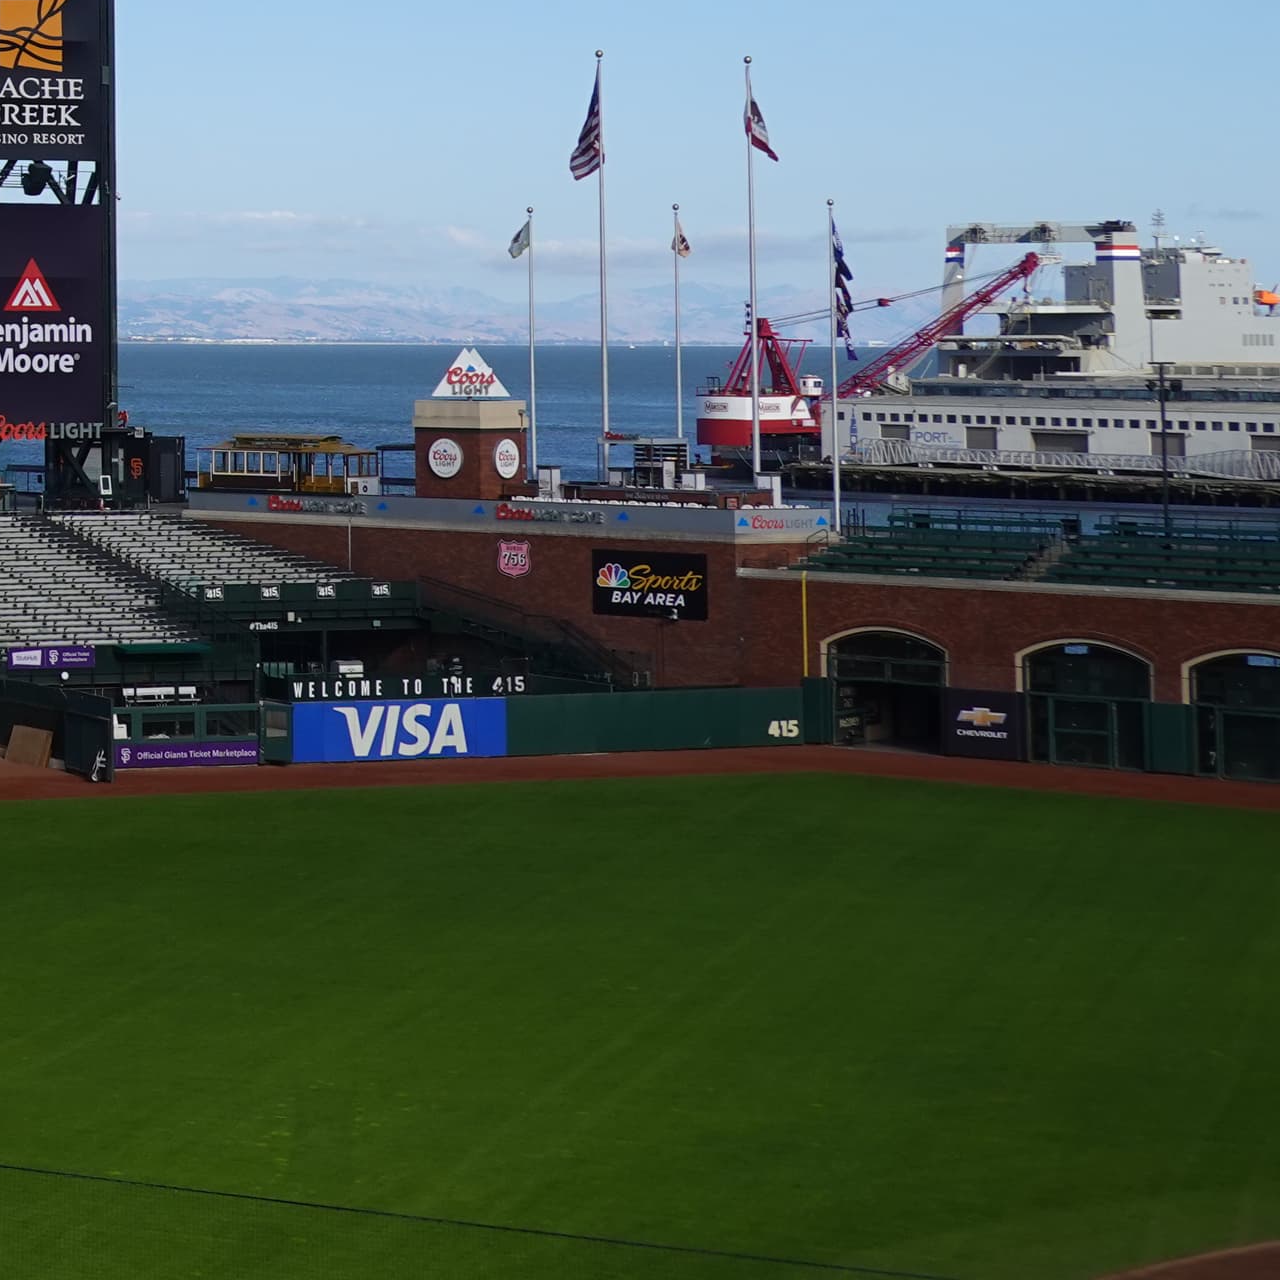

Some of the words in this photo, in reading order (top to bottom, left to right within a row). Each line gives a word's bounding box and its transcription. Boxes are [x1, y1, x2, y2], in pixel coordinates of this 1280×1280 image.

[33, 133, 85, 145] RESORT
[447, 367, 495, 385] Coors
[452, 385, 490, 395] LIGHT
[50, 422, 104, 440] LIGHT
[751, 514, 784, 530] Coors
[785, 518, 816, 530] LIGHT
[502, 552, 526, 567] 756
[629, 564, 703, 592] Sports
[611, 591, 641, 605] BAY
[644, 592, 686, 607] AREA
[293, 679, 383, 698] WELCOME
[403, 678, 422, 695] TO
[442, 676, 473, 695] THE
[492, 675, 526, 694] 415
[332, 703, 468, 757] VISA
[767, 720, 800, 738] 415
[956, 728, 1008, 740] CHEVROLET
[137, 750, 163, 761] Official
[164, 749, 188, 760] Giants
[189, 749, 211, 759] Ticket
[211, 747, 257, 760] Marketplace
